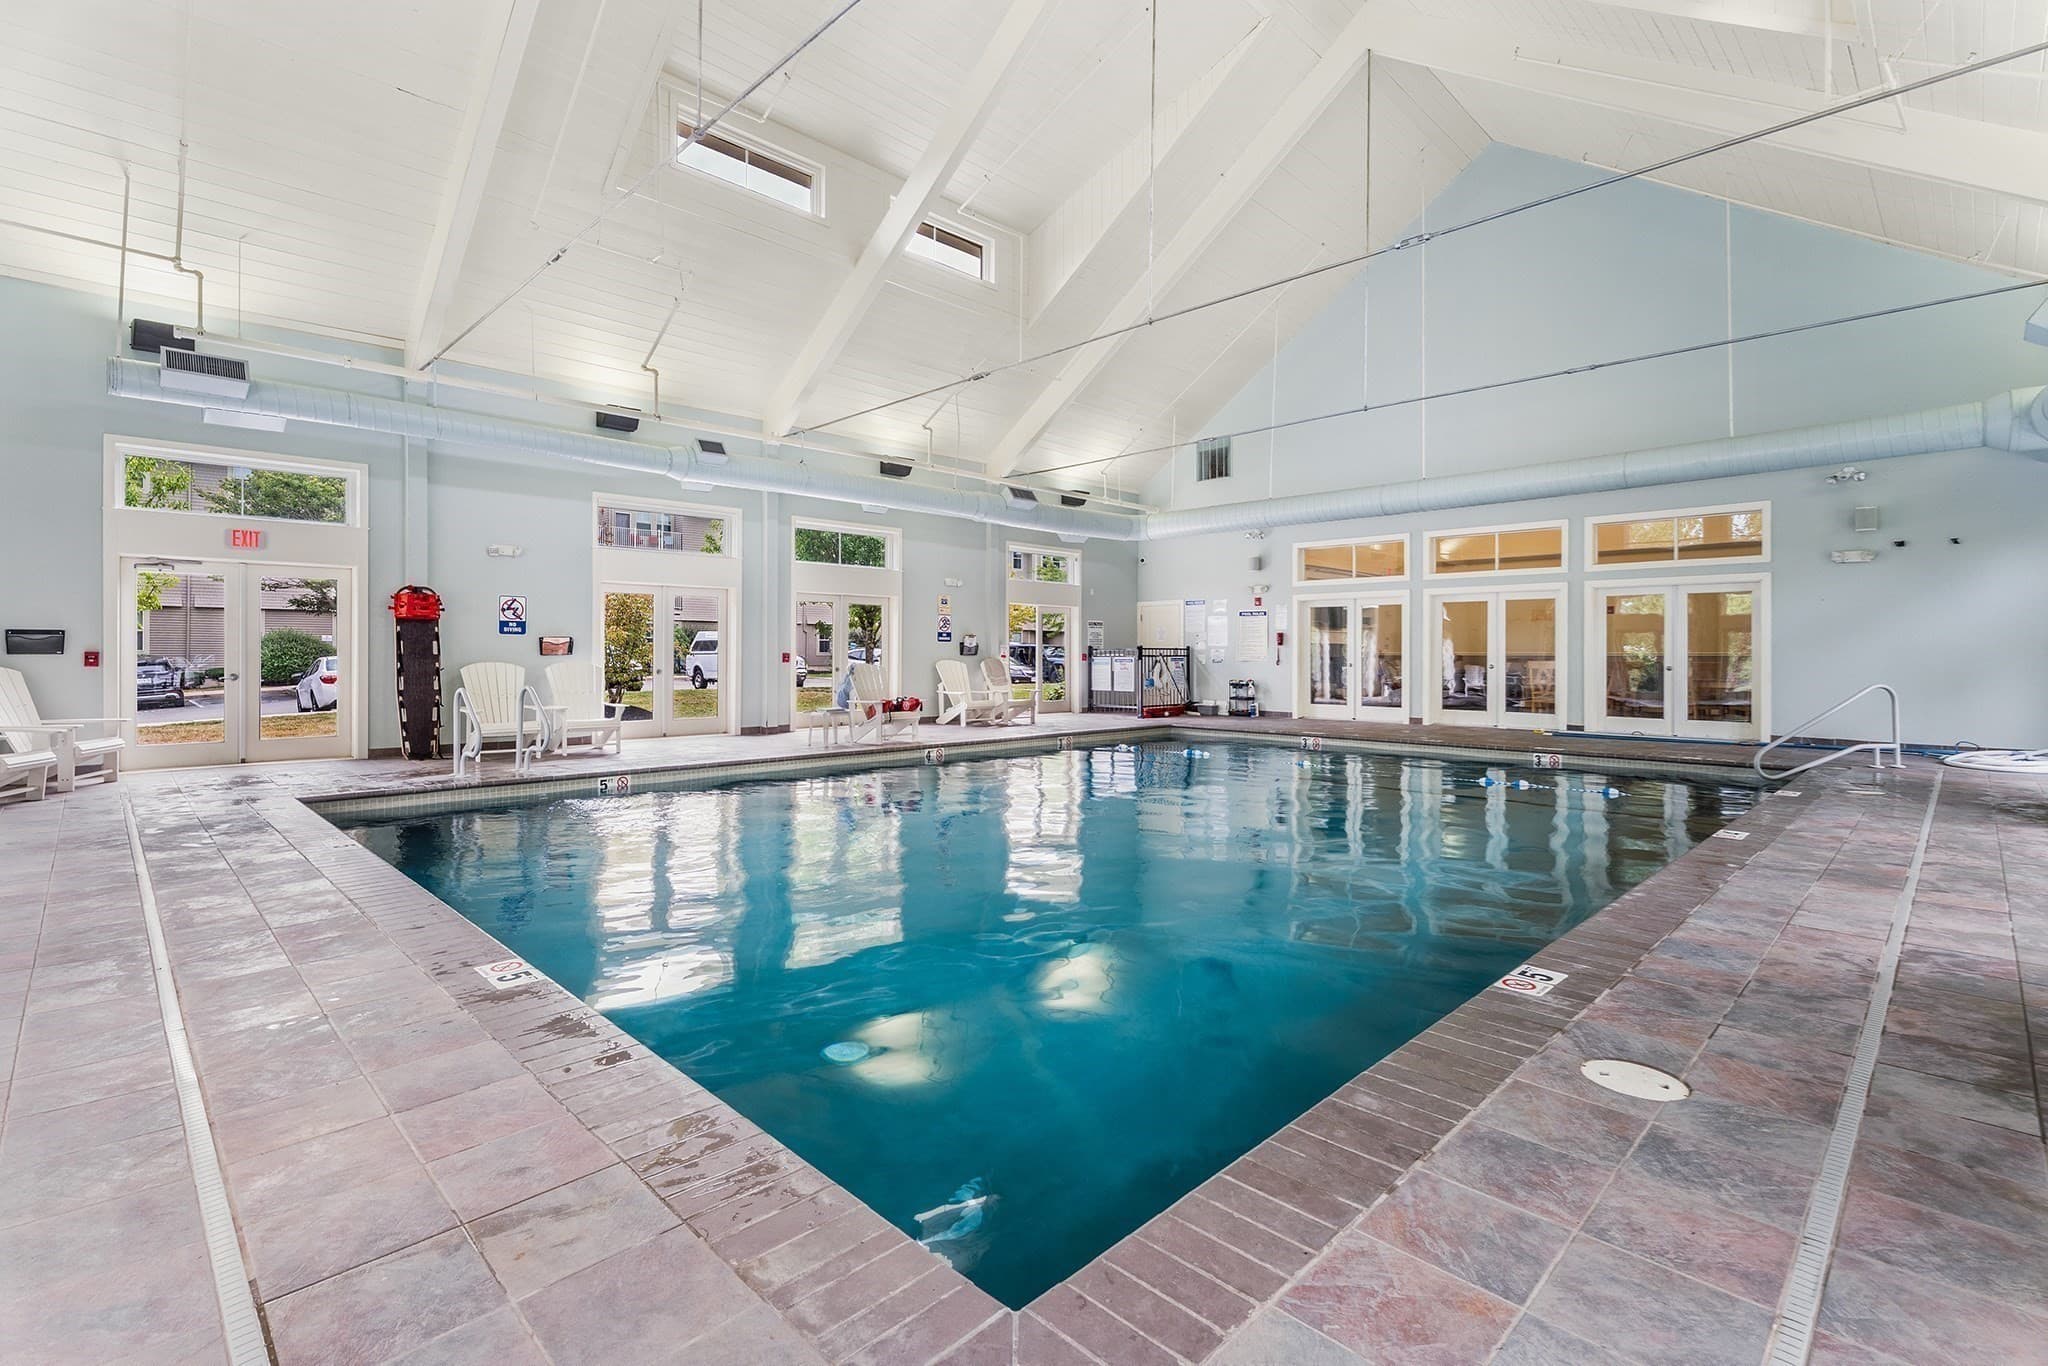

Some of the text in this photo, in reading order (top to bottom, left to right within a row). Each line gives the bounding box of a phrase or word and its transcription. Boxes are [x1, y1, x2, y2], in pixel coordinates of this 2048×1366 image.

[232, 529, 261, 548] EXIT
[1302, 737, 1308, 748] 3
[926, 750, 931, 763] 4
[1535, 754, 1541, 767] 3
[600, 779, 608, 793] 5
[496, 970, 532, 982] 5
[1517, 970, 1554, 982] 5
